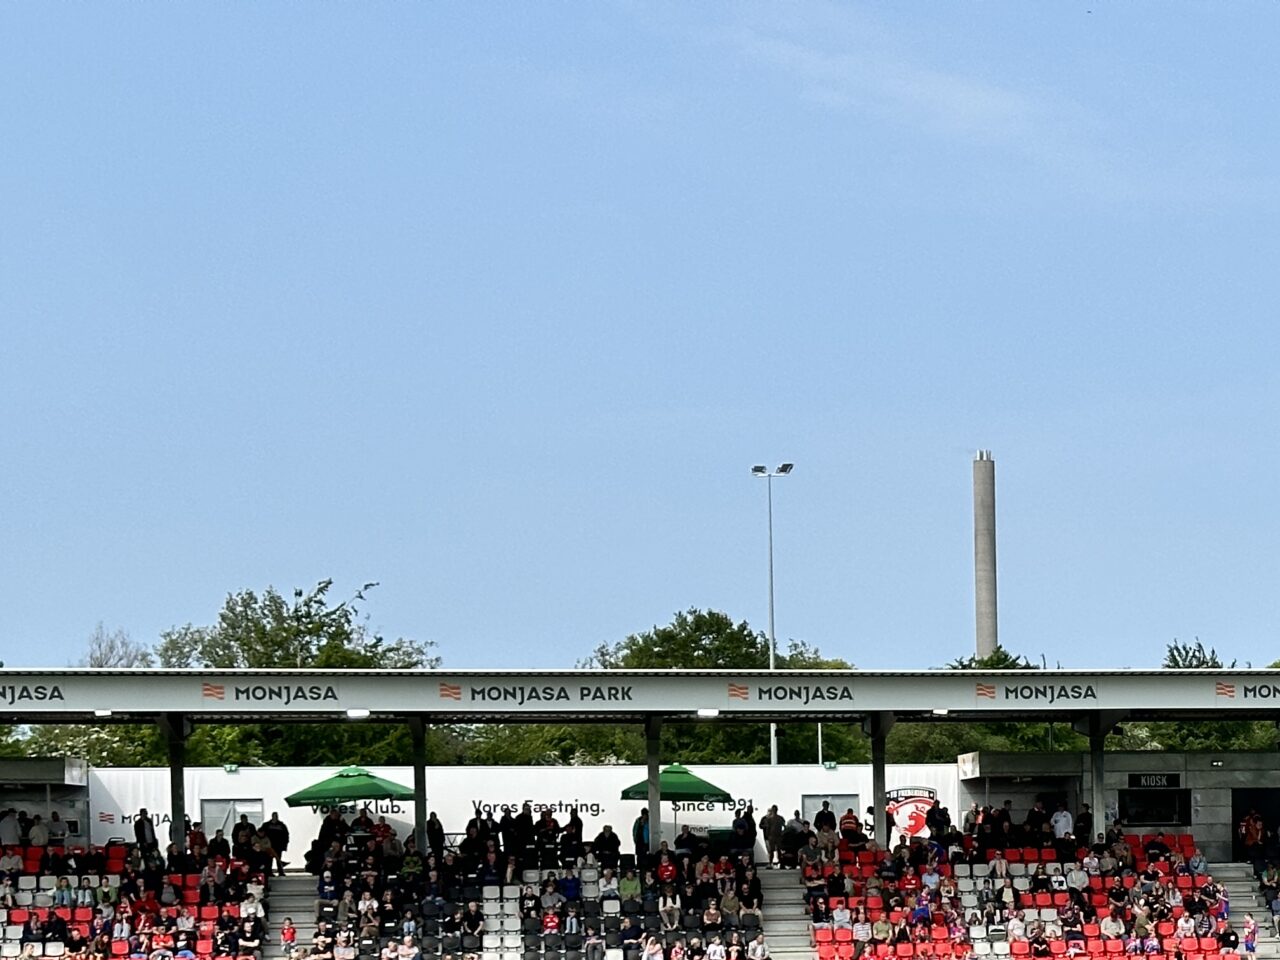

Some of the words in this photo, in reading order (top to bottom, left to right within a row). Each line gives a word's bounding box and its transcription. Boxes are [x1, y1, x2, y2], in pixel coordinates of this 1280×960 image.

[235, 685, 338, 705] MONJASA
[470, 686, 569, 706] MONJASA
[579, 686, 633, 701] PARK
[759, 685, 853, 705] MONJASA
[1004, 685, 1097, 704] MONJASA
[1140, 775, 1168, 787] KIOSK
[363, 799, 406, 815] Klub.
[121, 813, 191, 827] MJAA
